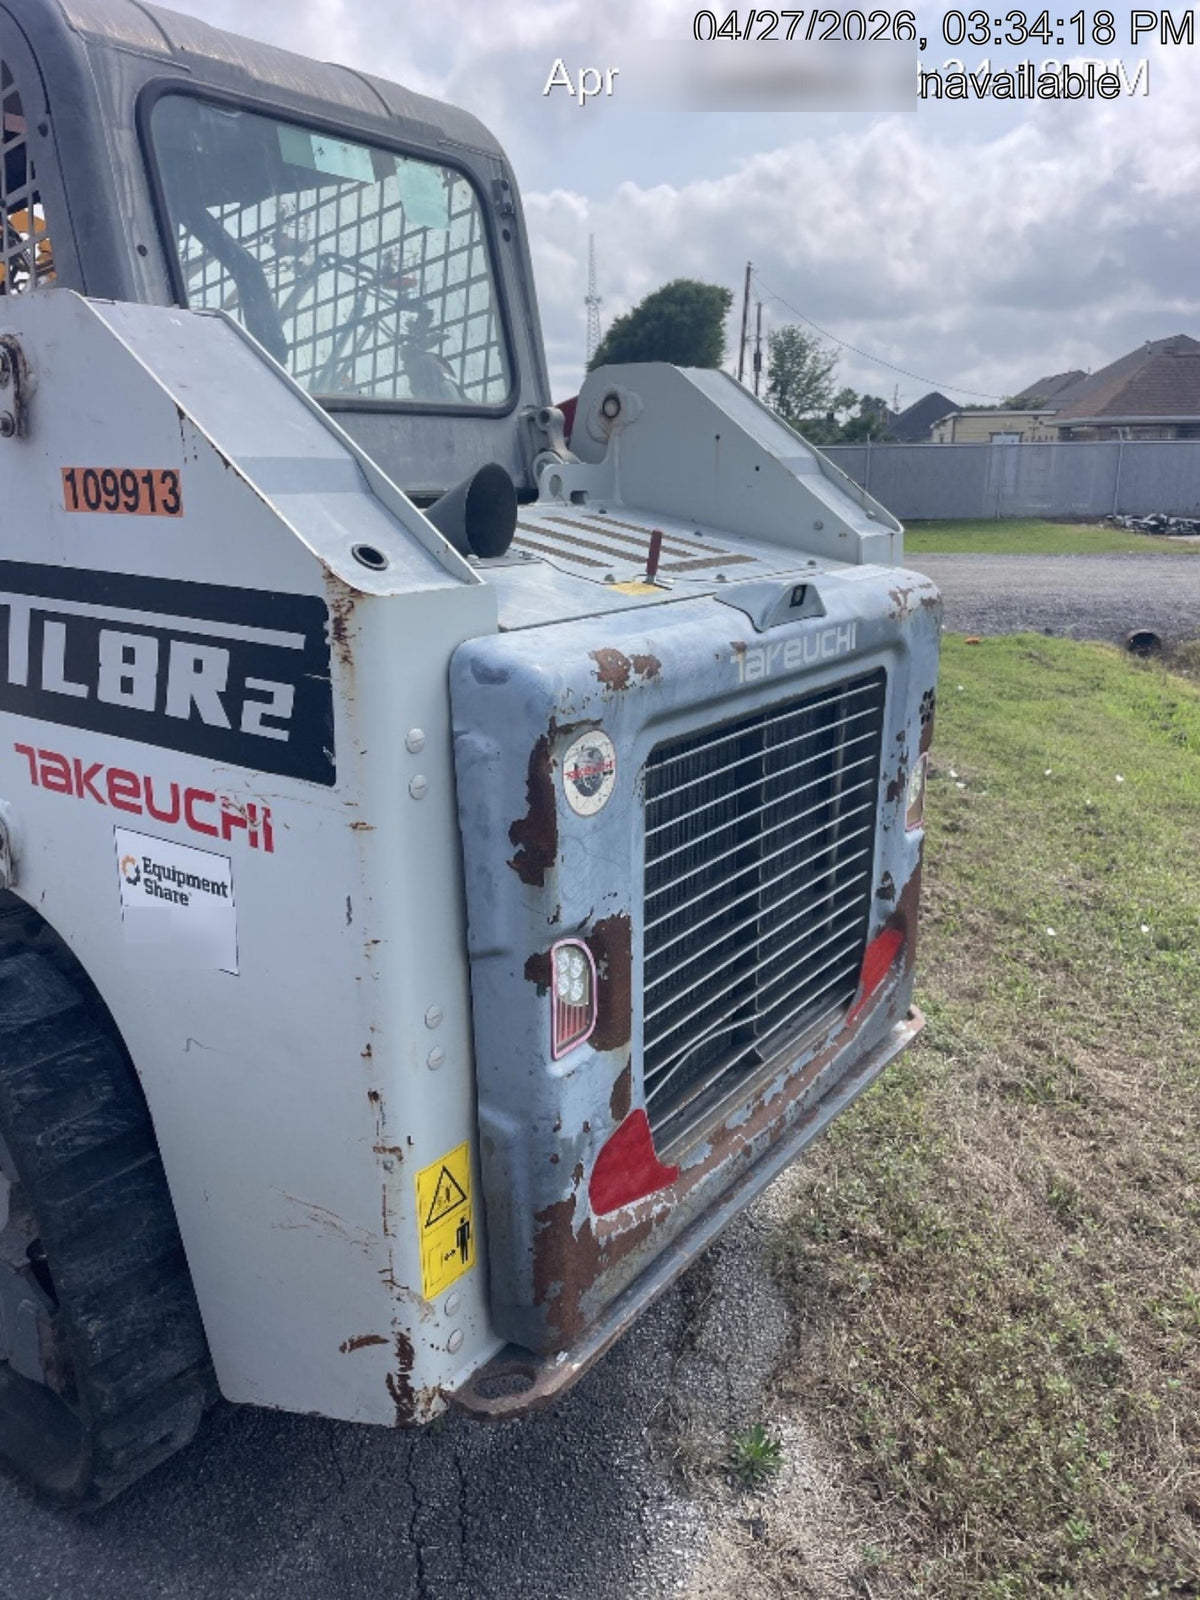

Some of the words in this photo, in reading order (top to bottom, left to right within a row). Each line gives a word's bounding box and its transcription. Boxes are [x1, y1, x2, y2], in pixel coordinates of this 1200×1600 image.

[64, 468, 181, 515] 109913
[142, 856, 228, 898] Equipment
[143, 877, 190, 906] Share
